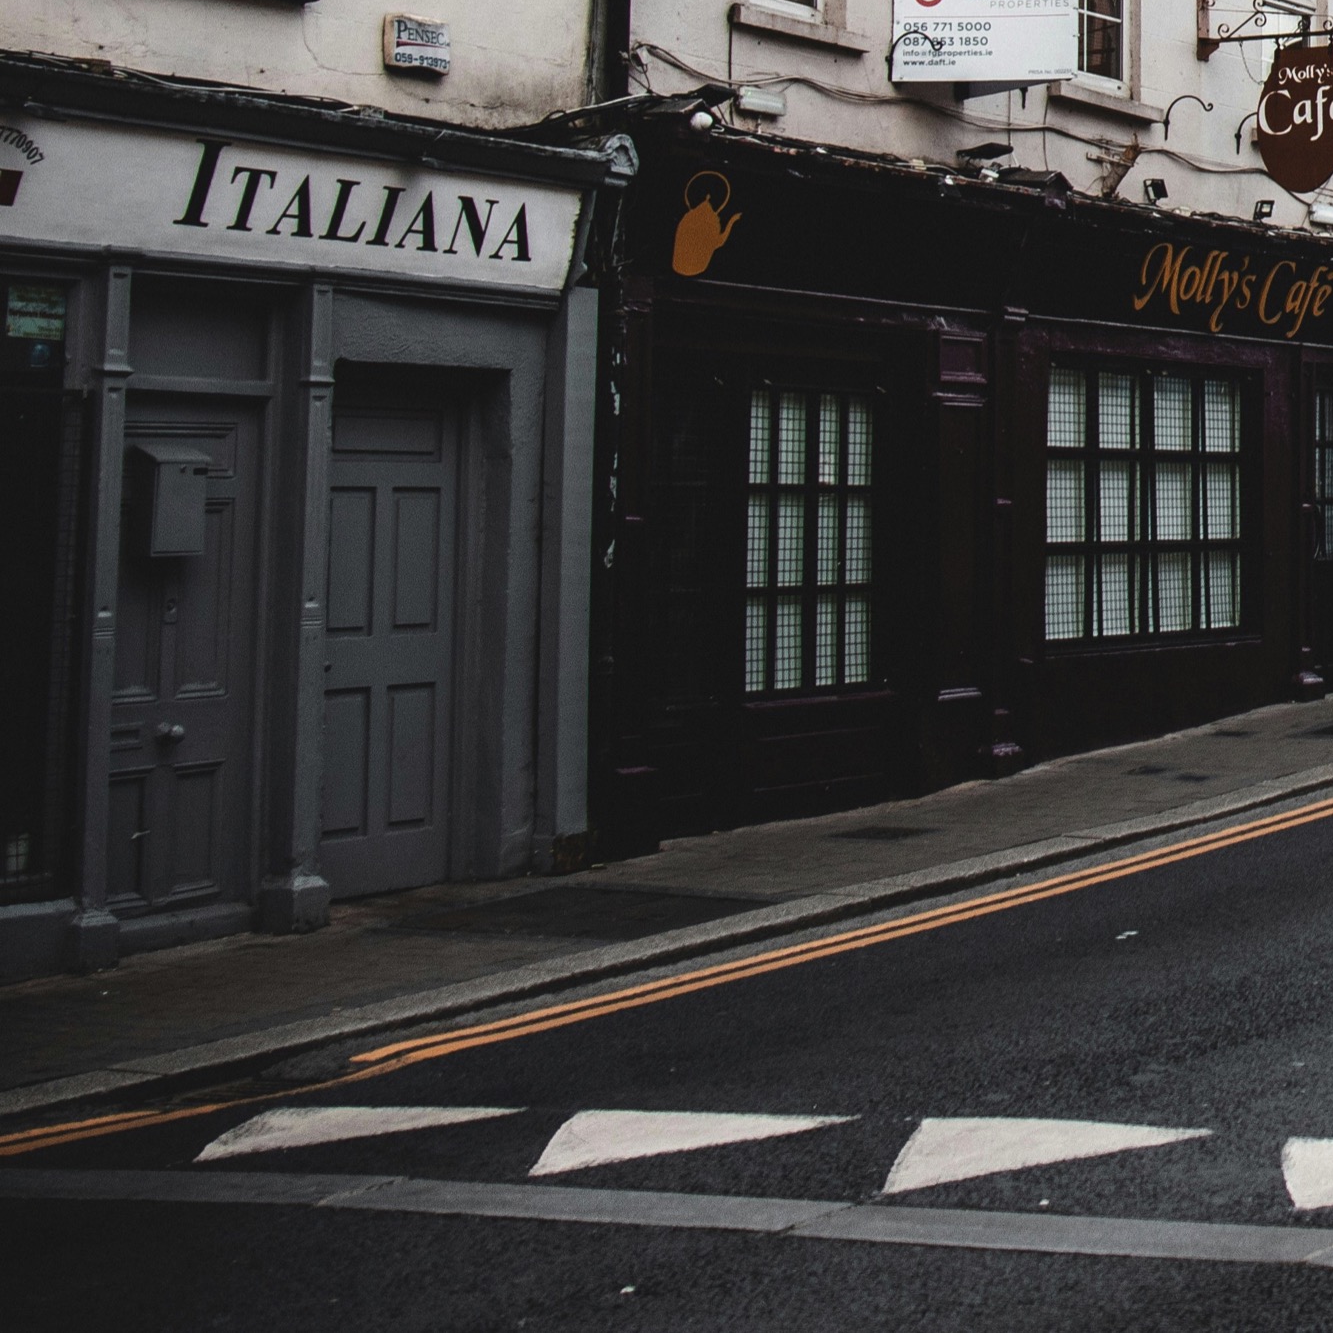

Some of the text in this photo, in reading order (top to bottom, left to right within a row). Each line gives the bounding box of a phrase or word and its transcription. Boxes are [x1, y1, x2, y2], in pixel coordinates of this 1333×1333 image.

[903, 21, 992, 32] 056 771 5000
[903, 36, 929, 47] 087
[959, 36, 989, 47] 1850
[902, 58, 957, 67] www.daft.ie
[1278, 63, 1333, 86] Molly's
[172, 138, 533, 262] ITALIANA
[1133, 242, 1257, 333] Molly's
